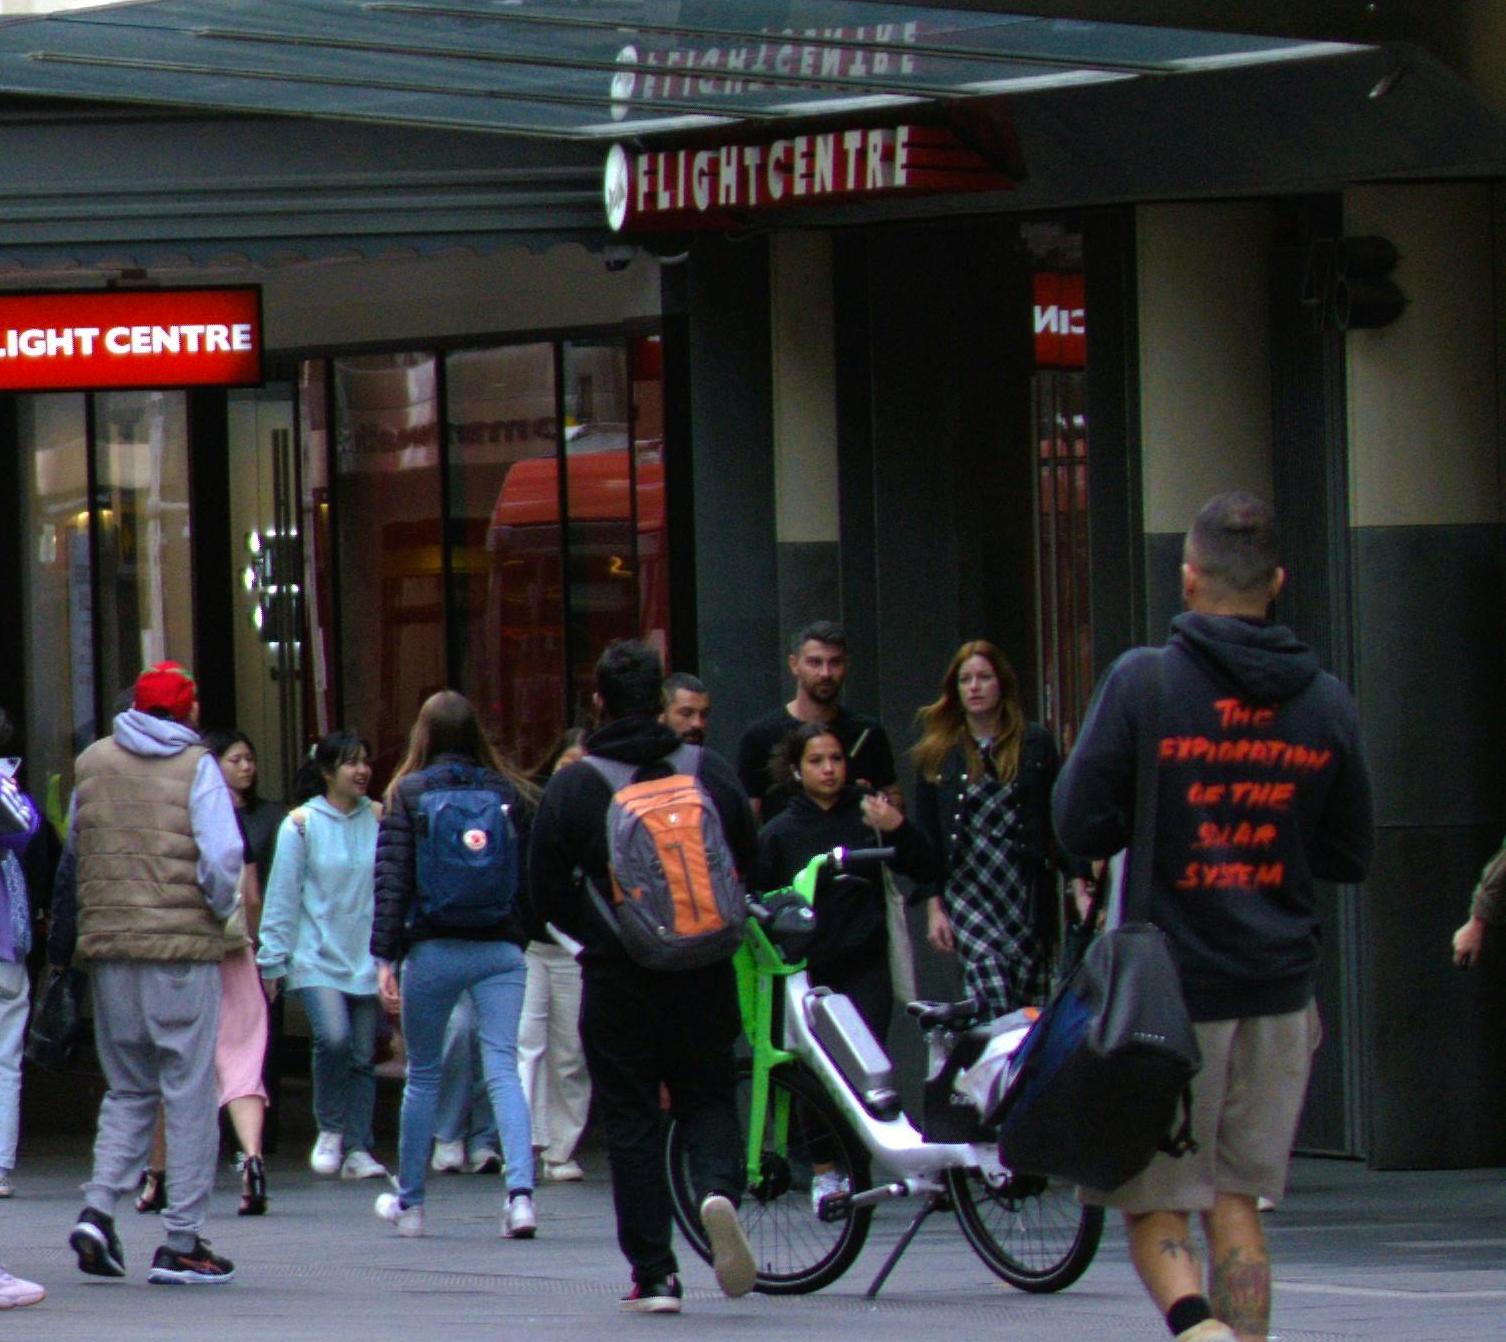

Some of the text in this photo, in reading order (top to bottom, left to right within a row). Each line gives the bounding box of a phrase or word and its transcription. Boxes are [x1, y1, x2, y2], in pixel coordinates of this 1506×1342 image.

[637, 125, 911, 211] FLIGHT CENTRE
[105, 324, 252, 354] CENTRE
[1231, 782, 1296, 810] THE
